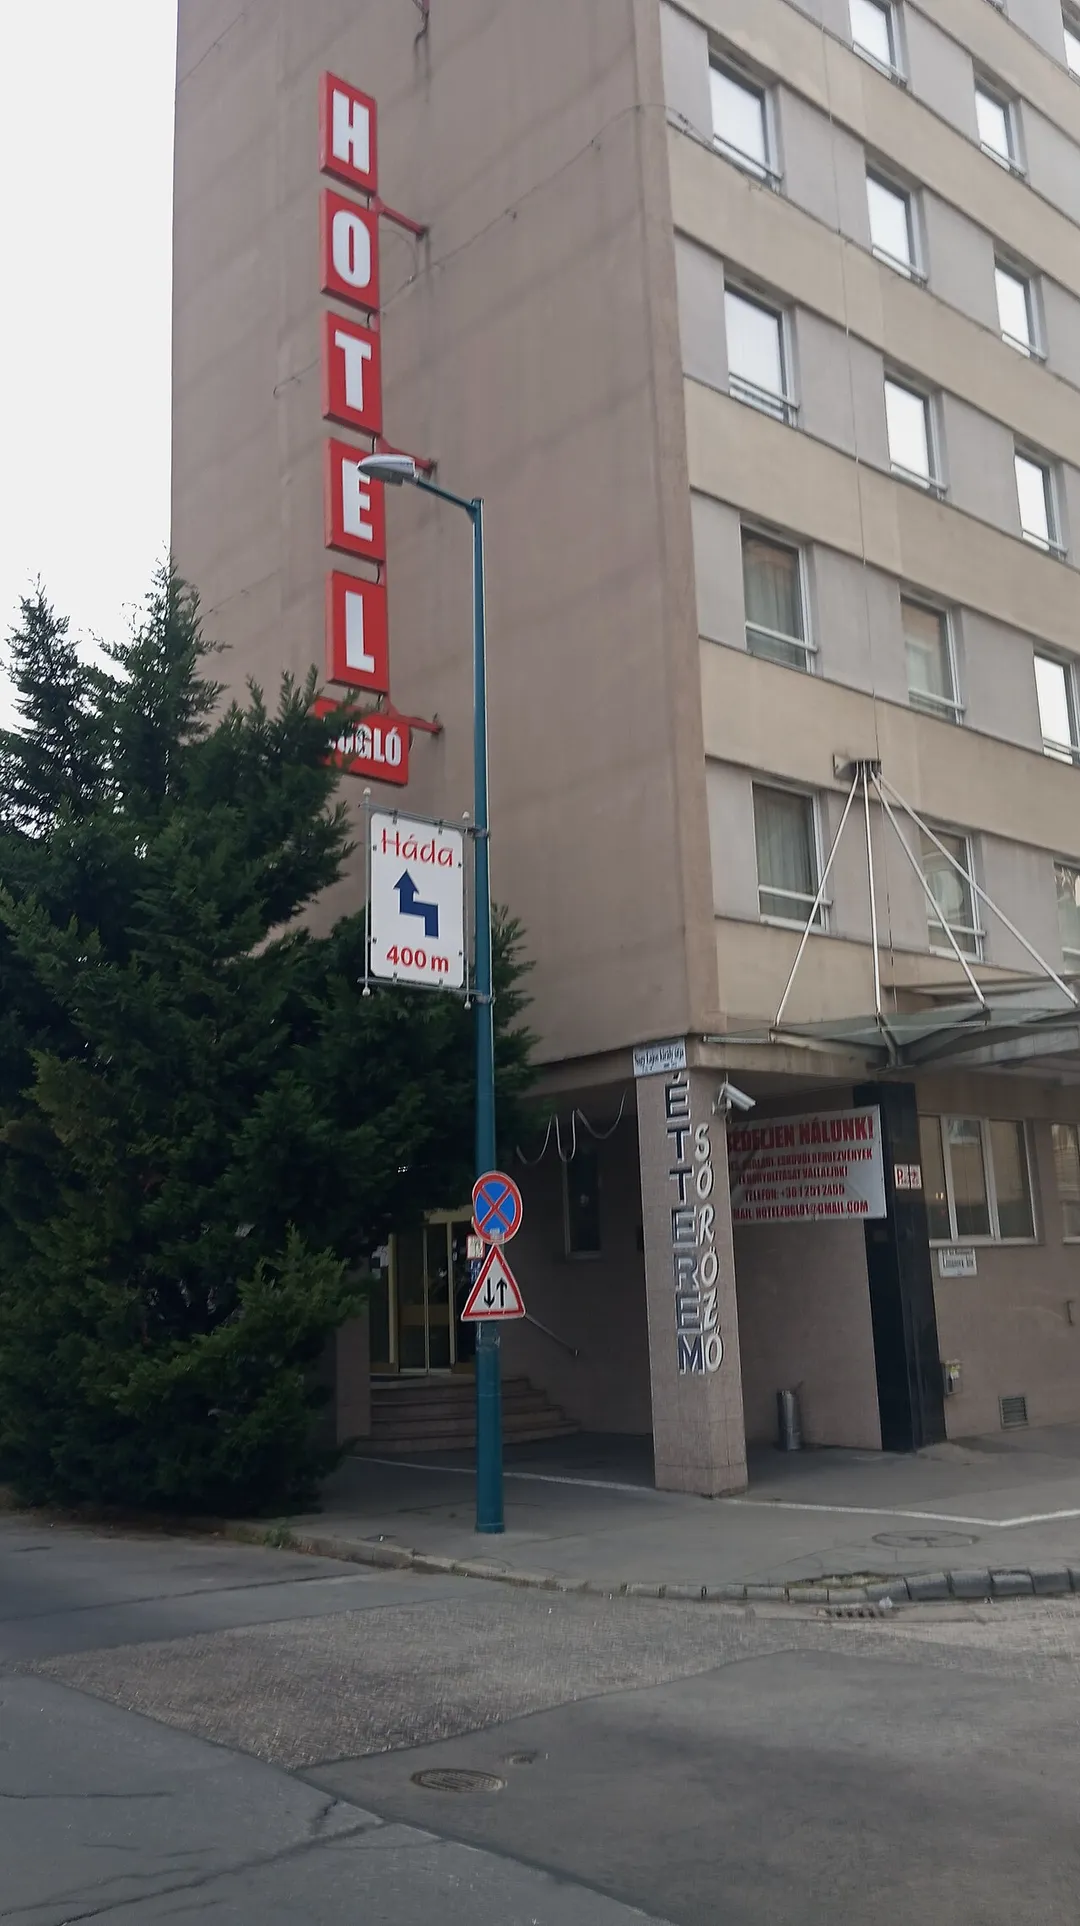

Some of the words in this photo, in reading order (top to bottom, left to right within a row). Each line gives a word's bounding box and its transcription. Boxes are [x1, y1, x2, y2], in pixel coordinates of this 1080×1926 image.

[332, 87, 375, 674] HOTEL
[381, 828, 454, 868] Háda
[387, 944, 427, 970] 400
[431, 954, 449, 973] m
[800, 1115, 874, 1146] NÁLUNK!
